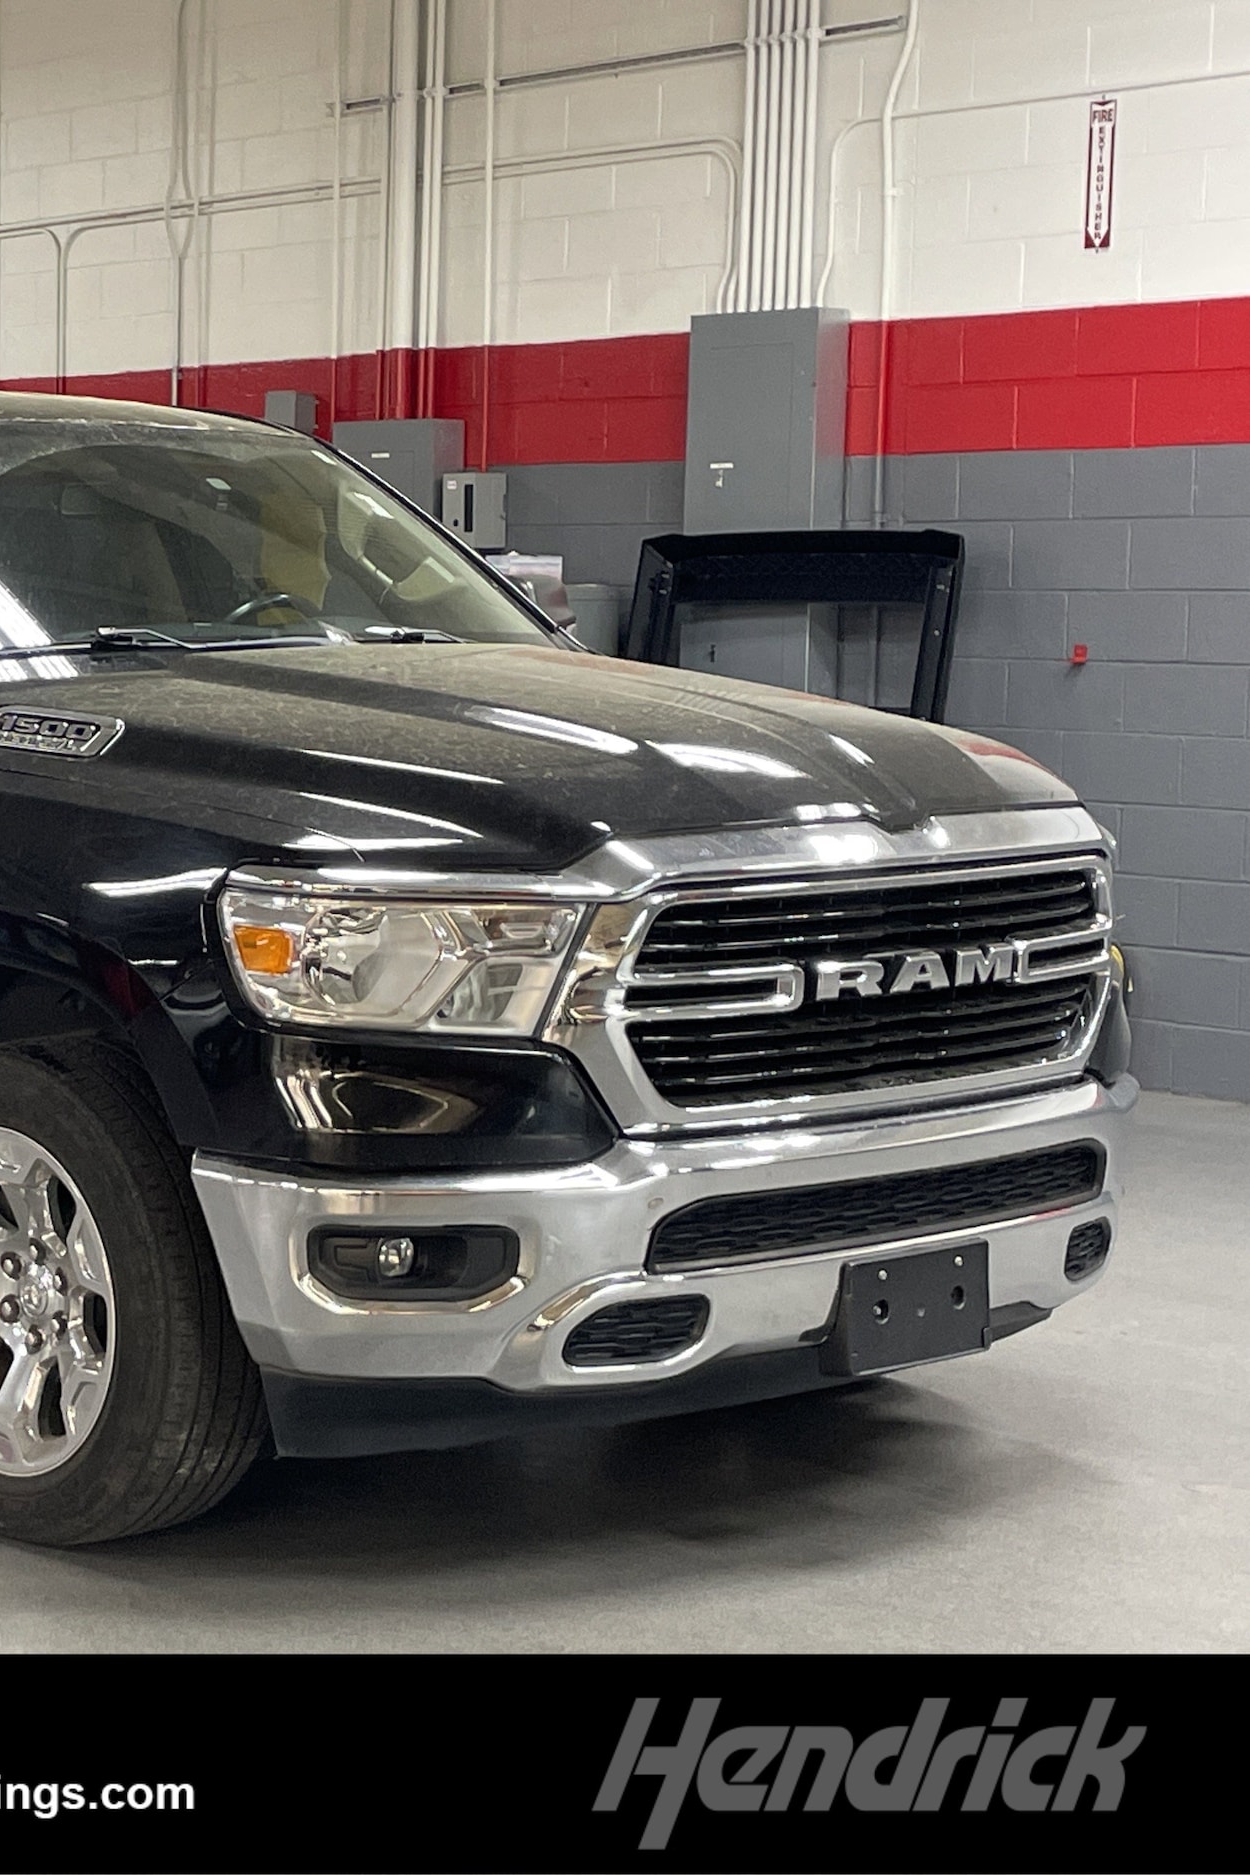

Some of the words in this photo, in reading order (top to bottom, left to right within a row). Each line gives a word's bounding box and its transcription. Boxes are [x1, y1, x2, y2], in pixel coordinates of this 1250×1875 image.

[1092, 108, 1114, 123] FIRE
[1093, 126, 1106, 240] EXTINGUISHER
[815, 942, 1016, 1002] RAM
